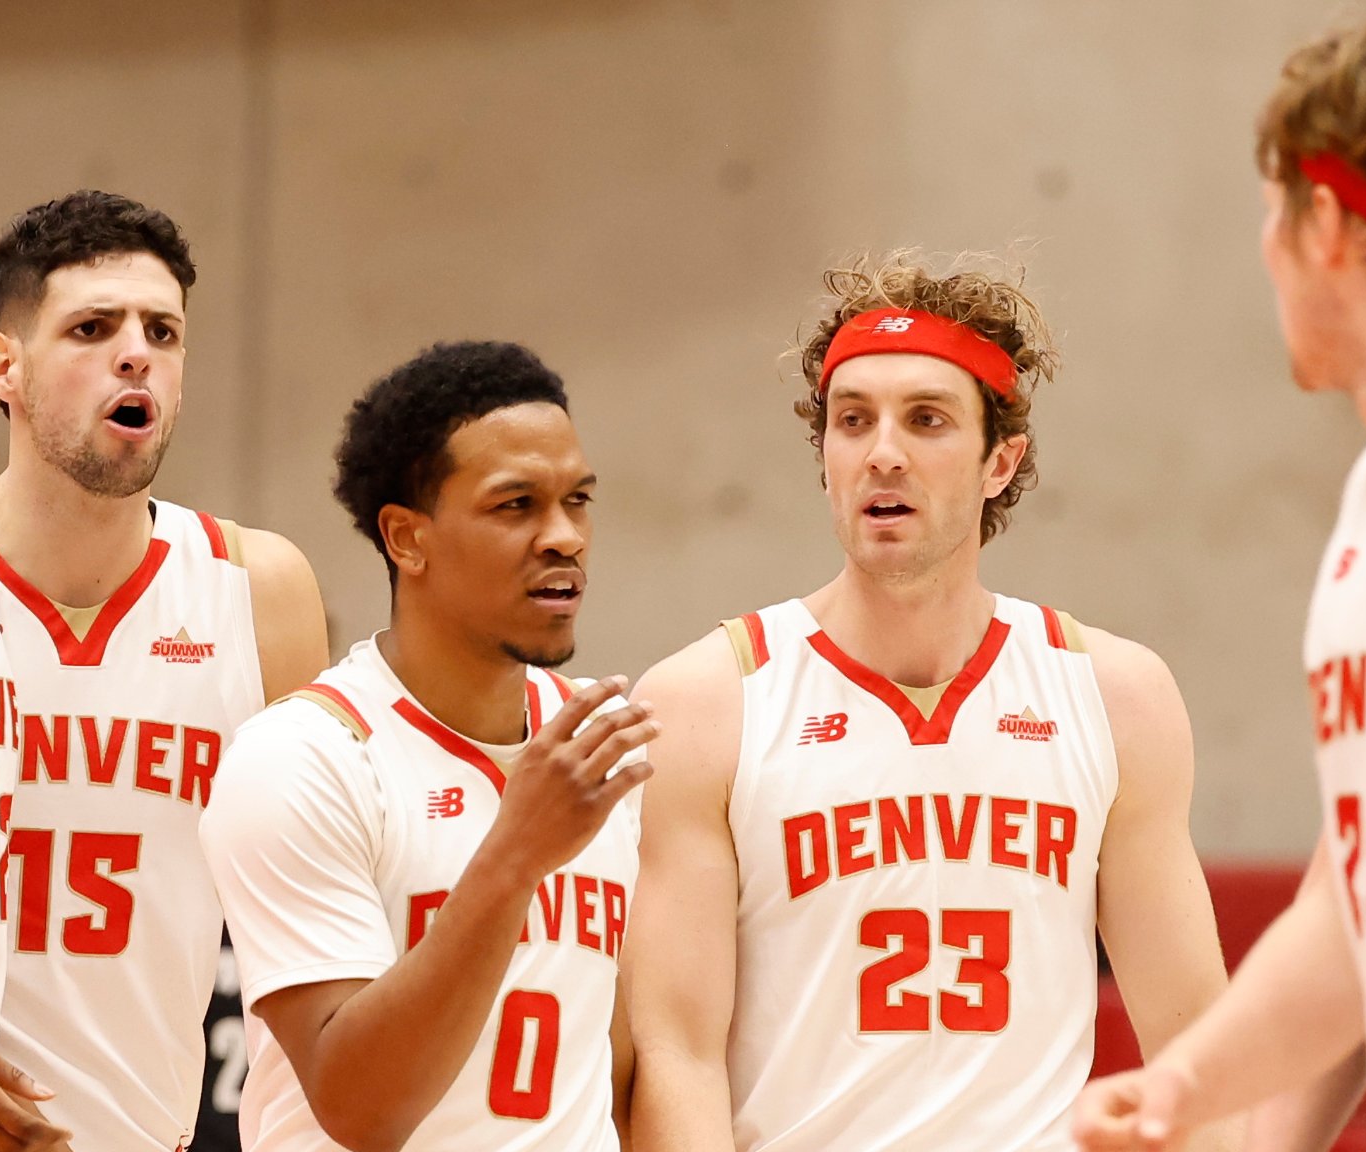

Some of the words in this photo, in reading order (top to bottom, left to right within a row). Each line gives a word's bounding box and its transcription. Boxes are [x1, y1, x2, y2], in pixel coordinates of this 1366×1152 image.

[150, 641, 215, 657] SUMMIT
[18, 713, 222, 809] NVER
[1013, 734, 1051, 742] LEAGUE
[8, 827, 143, 958] 15
[780, 793, 1078, 903] DENVER
[857, 908, 1013, 1035] 23
[487, 989, 561, 1122] 0
